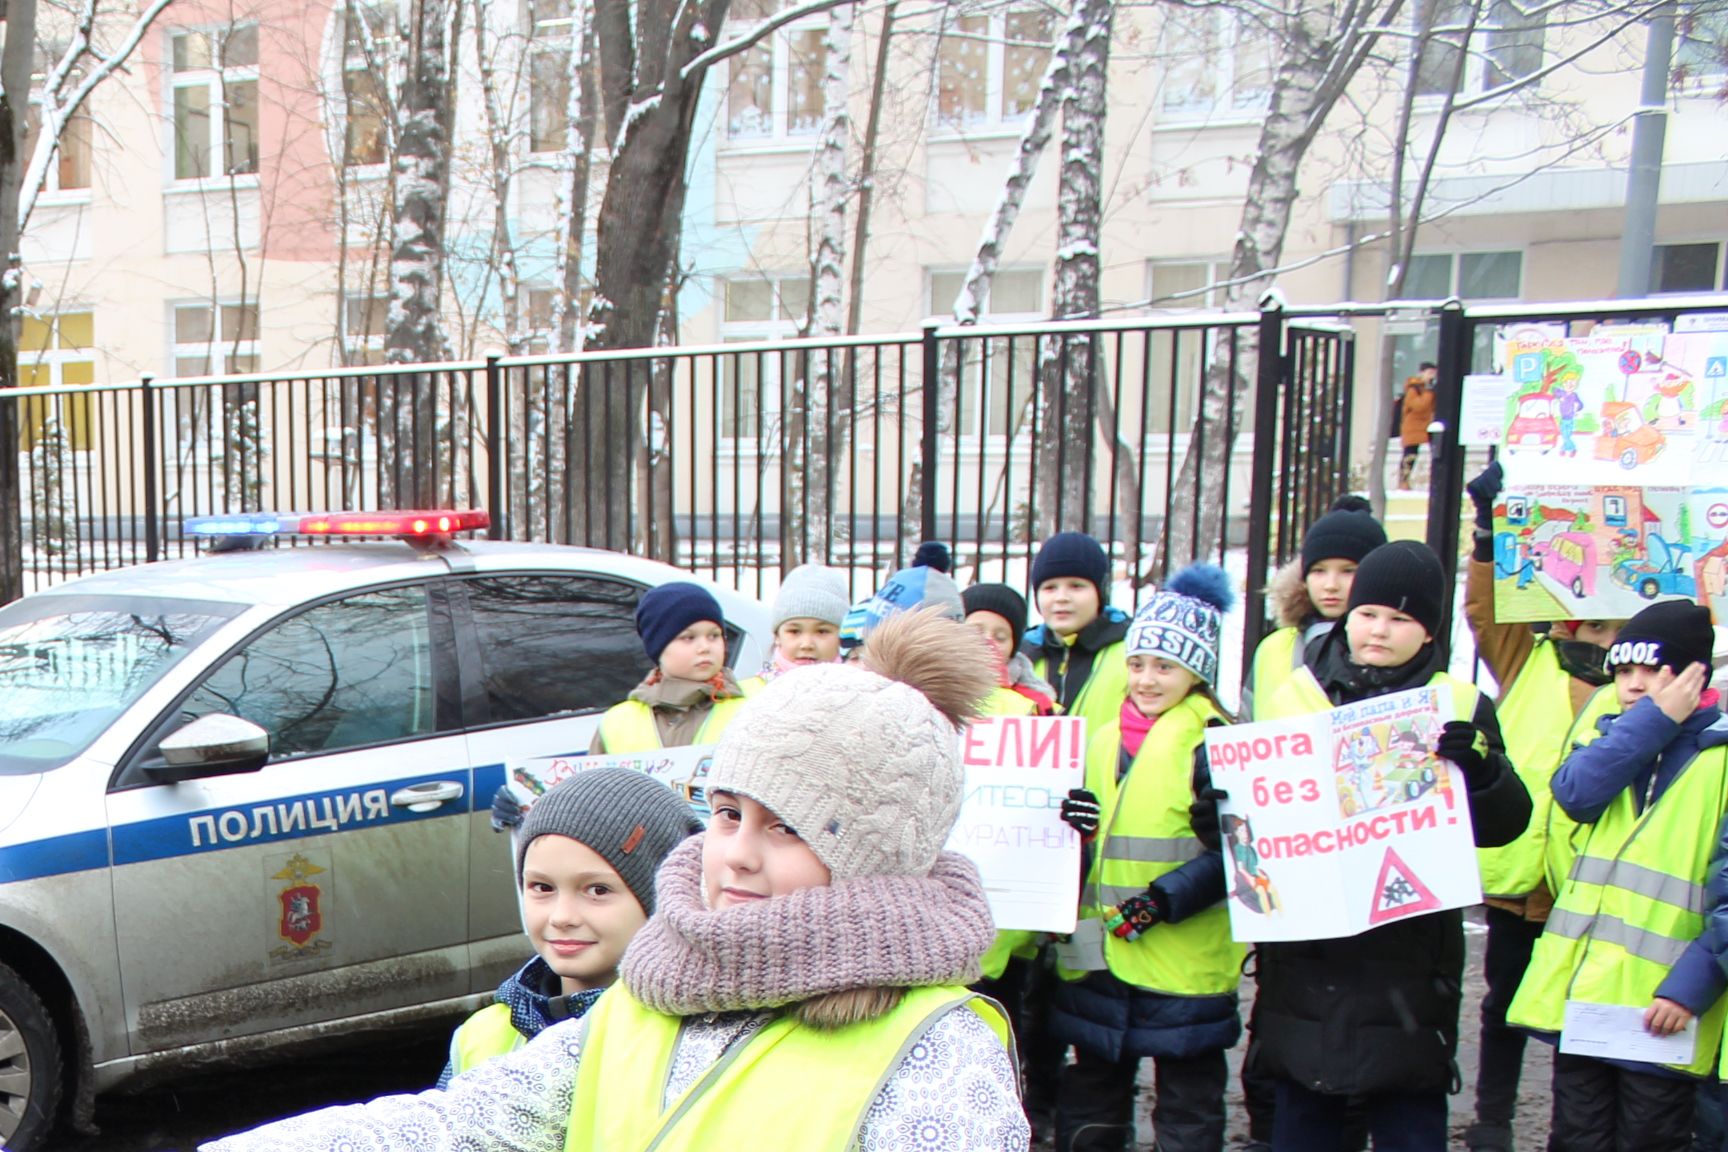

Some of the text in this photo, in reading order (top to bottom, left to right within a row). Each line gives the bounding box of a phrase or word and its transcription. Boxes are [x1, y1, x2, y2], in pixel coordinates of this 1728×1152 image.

[1125, 626, 1206, 673] USSIA
[1610, 641, 1660, 666] COOL
[963, 717, 1081, 770] ЕЛИ!
[1209, 732, 1313, 772] дорога
[962, 784, 1070, 810] ИТЕСЬ
[1252, 776, 1321, 807] без
[189, 788, 389, 848] ПОЛИЦИЯ
[1257, 785, 1459, 860] опасности!
